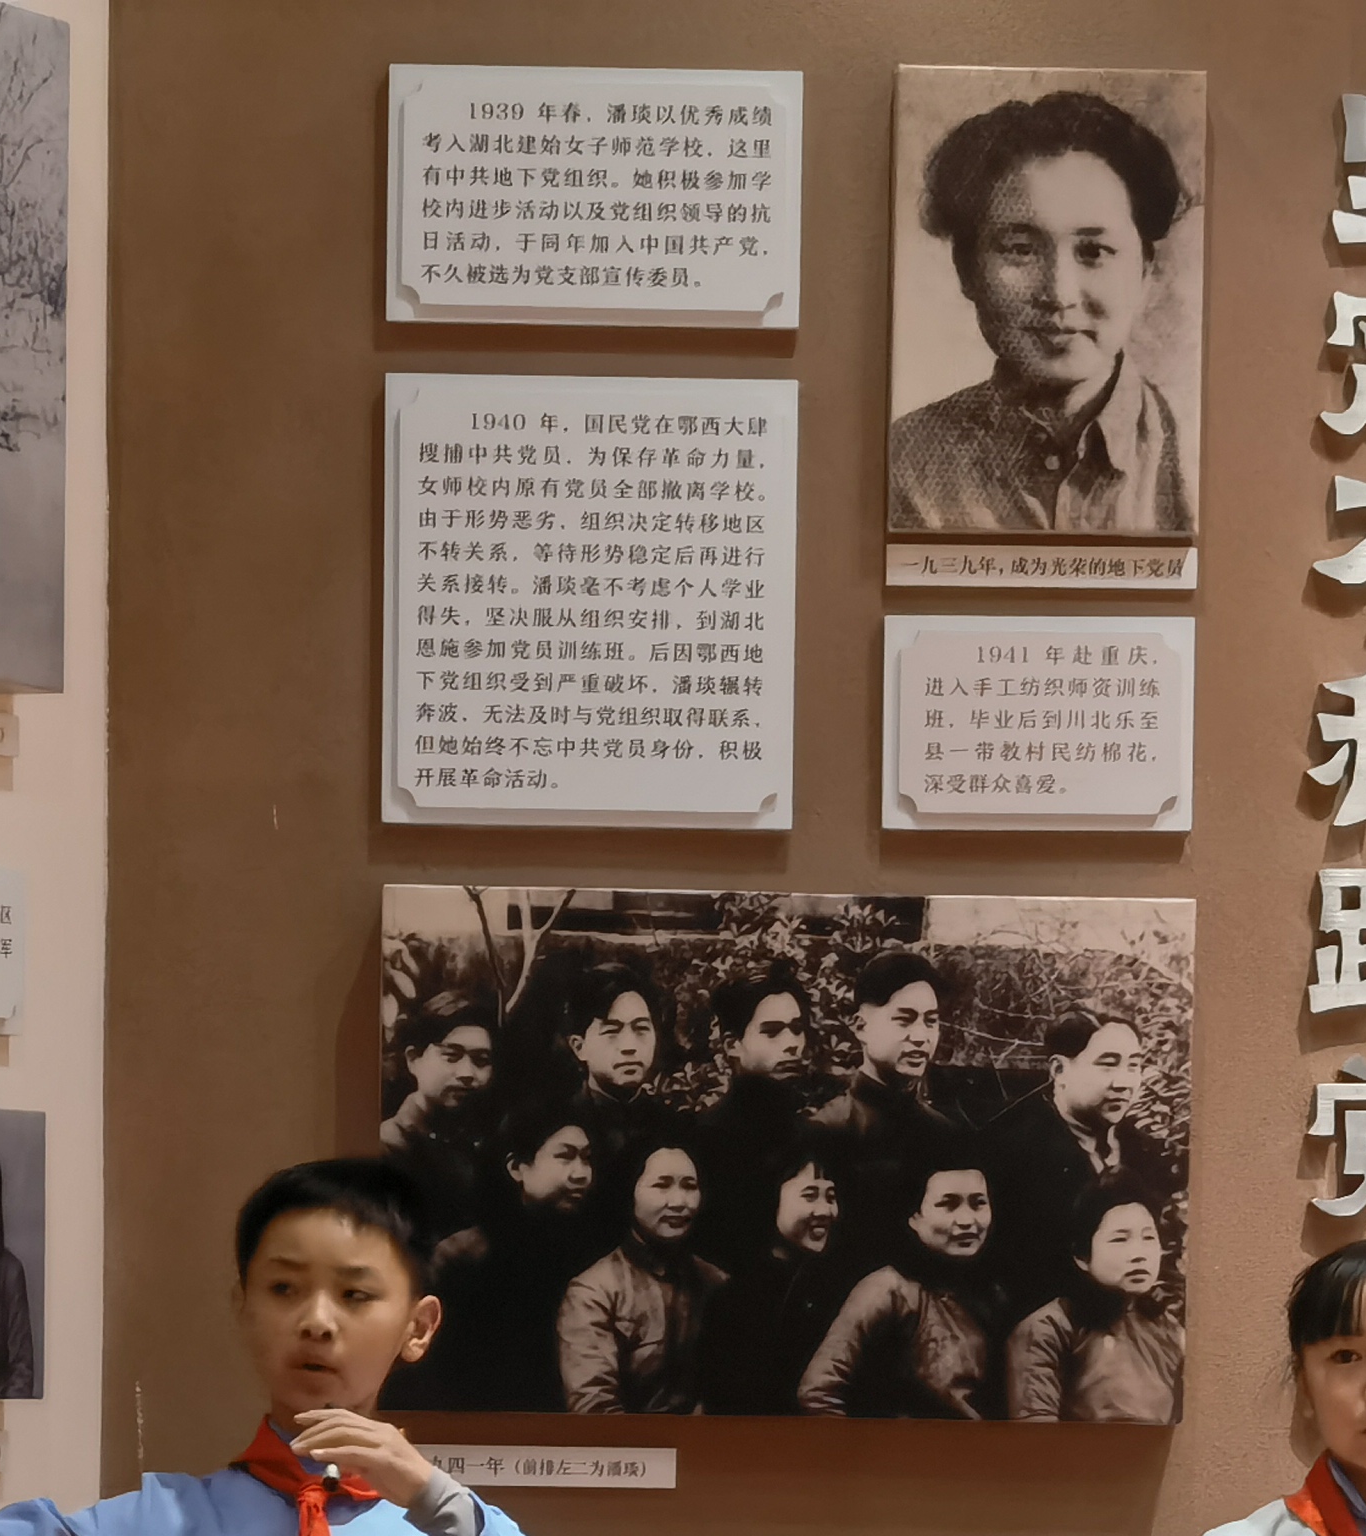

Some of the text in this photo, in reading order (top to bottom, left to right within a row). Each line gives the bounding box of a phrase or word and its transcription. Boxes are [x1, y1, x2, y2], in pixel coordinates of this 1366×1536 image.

[421, 198, 771, 225] 校内进步活动以及党组织领导的抗
[923, 676, 1161, 700] 进入手工纺织师资训练
[414, 767, 561, 791] 开展革命活动。
[923, 772, 1068, 795] 深受群众喜爱。
